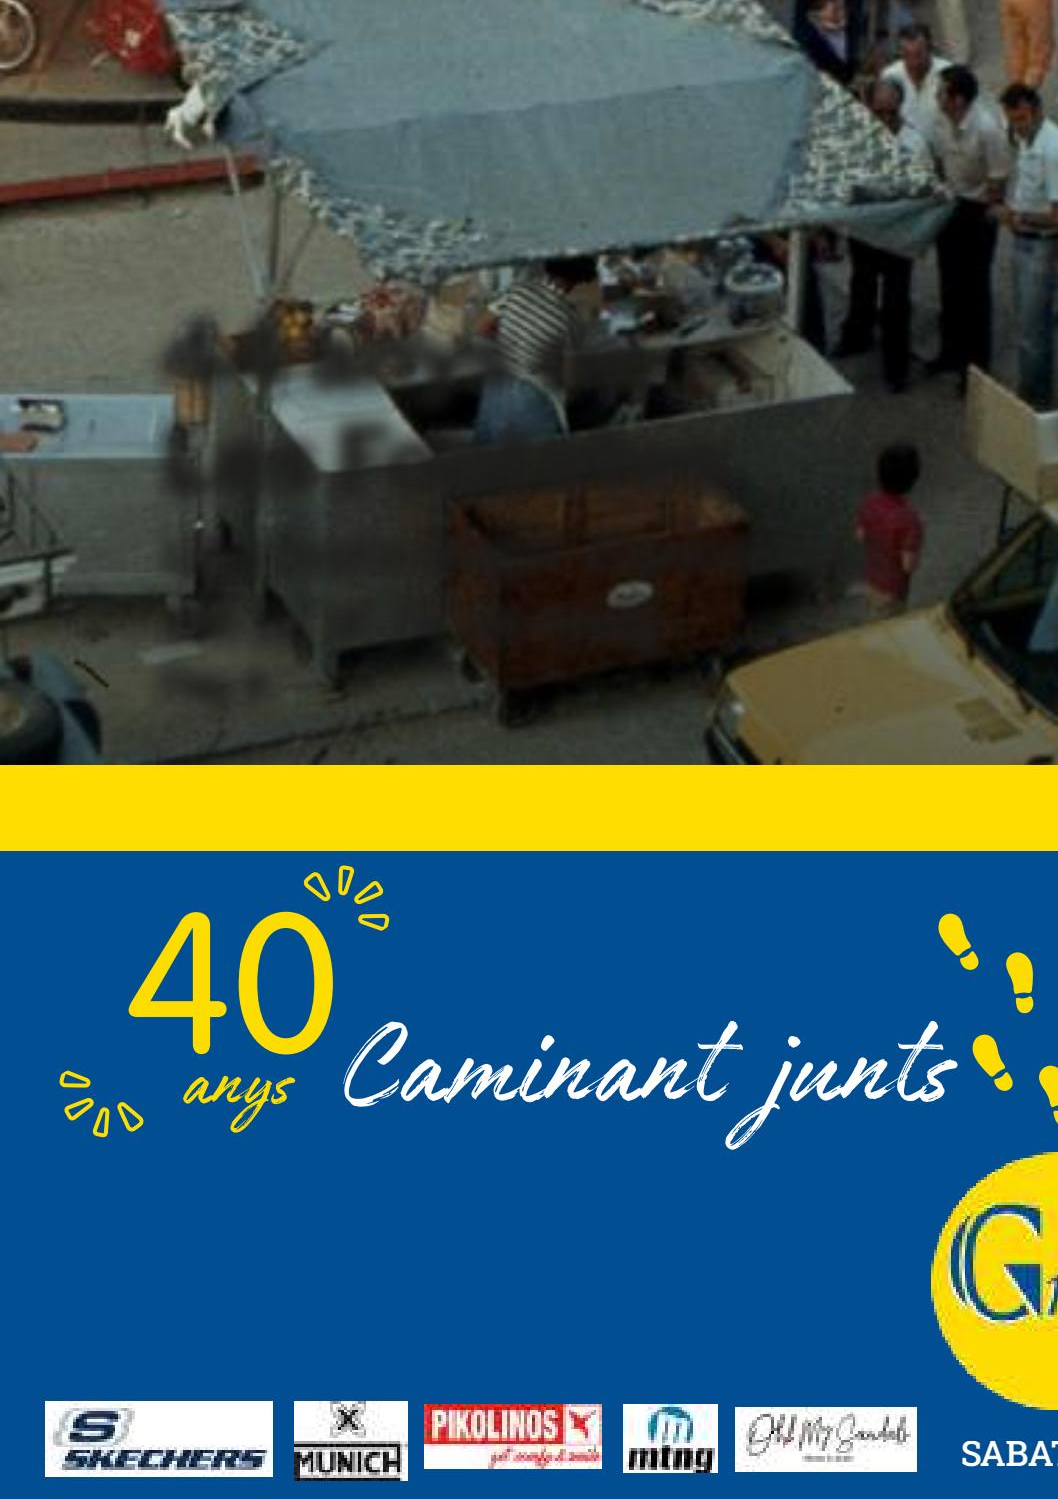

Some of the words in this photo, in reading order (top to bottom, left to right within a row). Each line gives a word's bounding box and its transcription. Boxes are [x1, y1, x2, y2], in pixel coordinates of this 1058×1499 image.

[128, 912, 334, 1055] 40
[344, 1021, 743, 1107] Caminant
[725, 1021, 959, 1150] junts
[183, 1075, 296, 1134] anys
[431, 1408, 559, 1441] PIKOLINOS
[62, 1449, 268, 1471] SKECHERS
[297, 1451, 402, 1474] MUNICH
[627, 1445, 716, 1473] mtng
